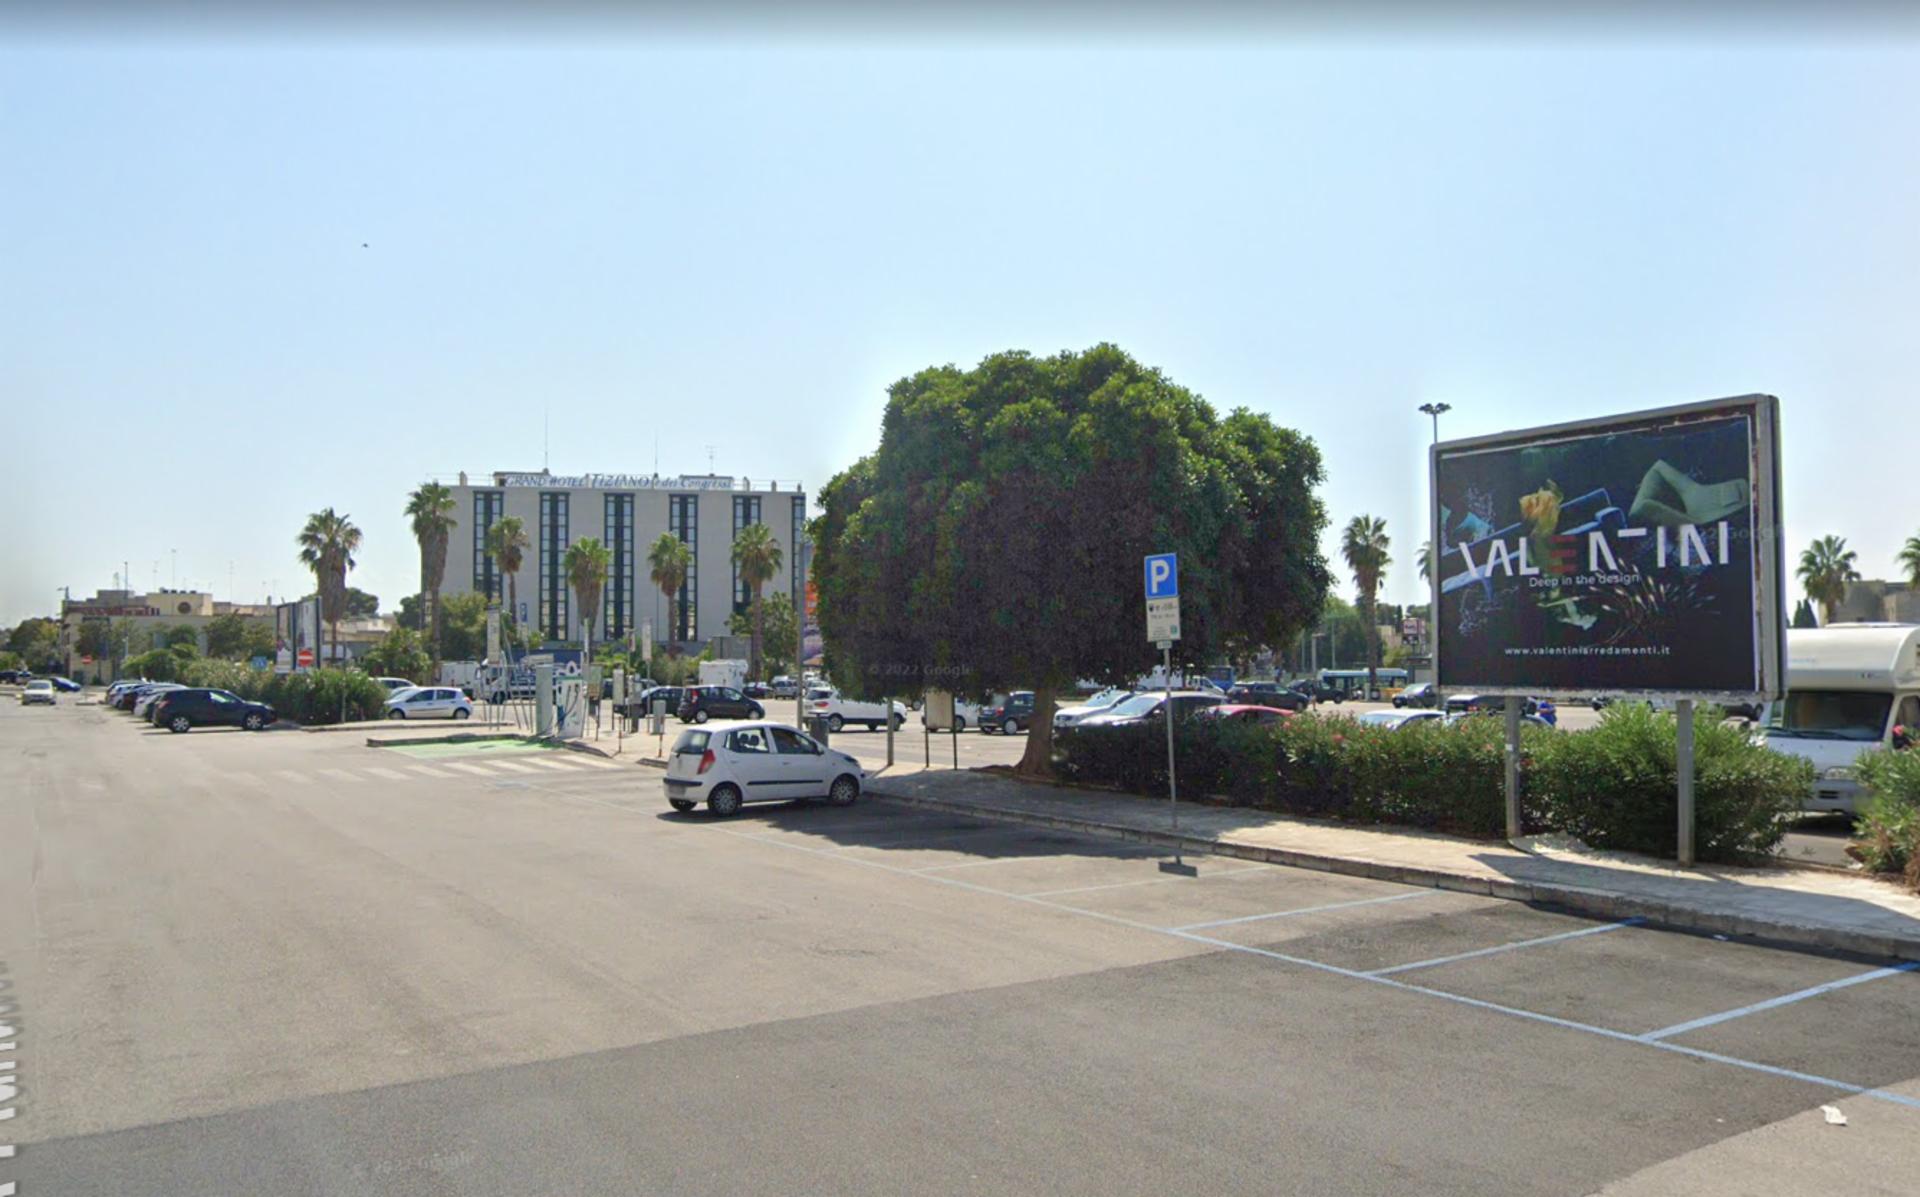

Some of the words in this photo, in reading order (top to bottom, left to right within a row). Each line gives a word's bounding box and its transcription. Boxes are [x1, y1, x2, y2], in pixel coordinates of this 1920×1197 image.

[505, 474, 545, 487] GRAND
[592, 473, 650, 488] TIZIANO
[1150, 559, 1170, 594] P
[1529, 576, 1558, 588] Deep
[1562, 575, 1572, 585] in
[1576, 575, 1595, 585] the
[1599, 573, 1640, 587] design
[1504, 645, 1671, 656] www.valentiniarredamenti.it
